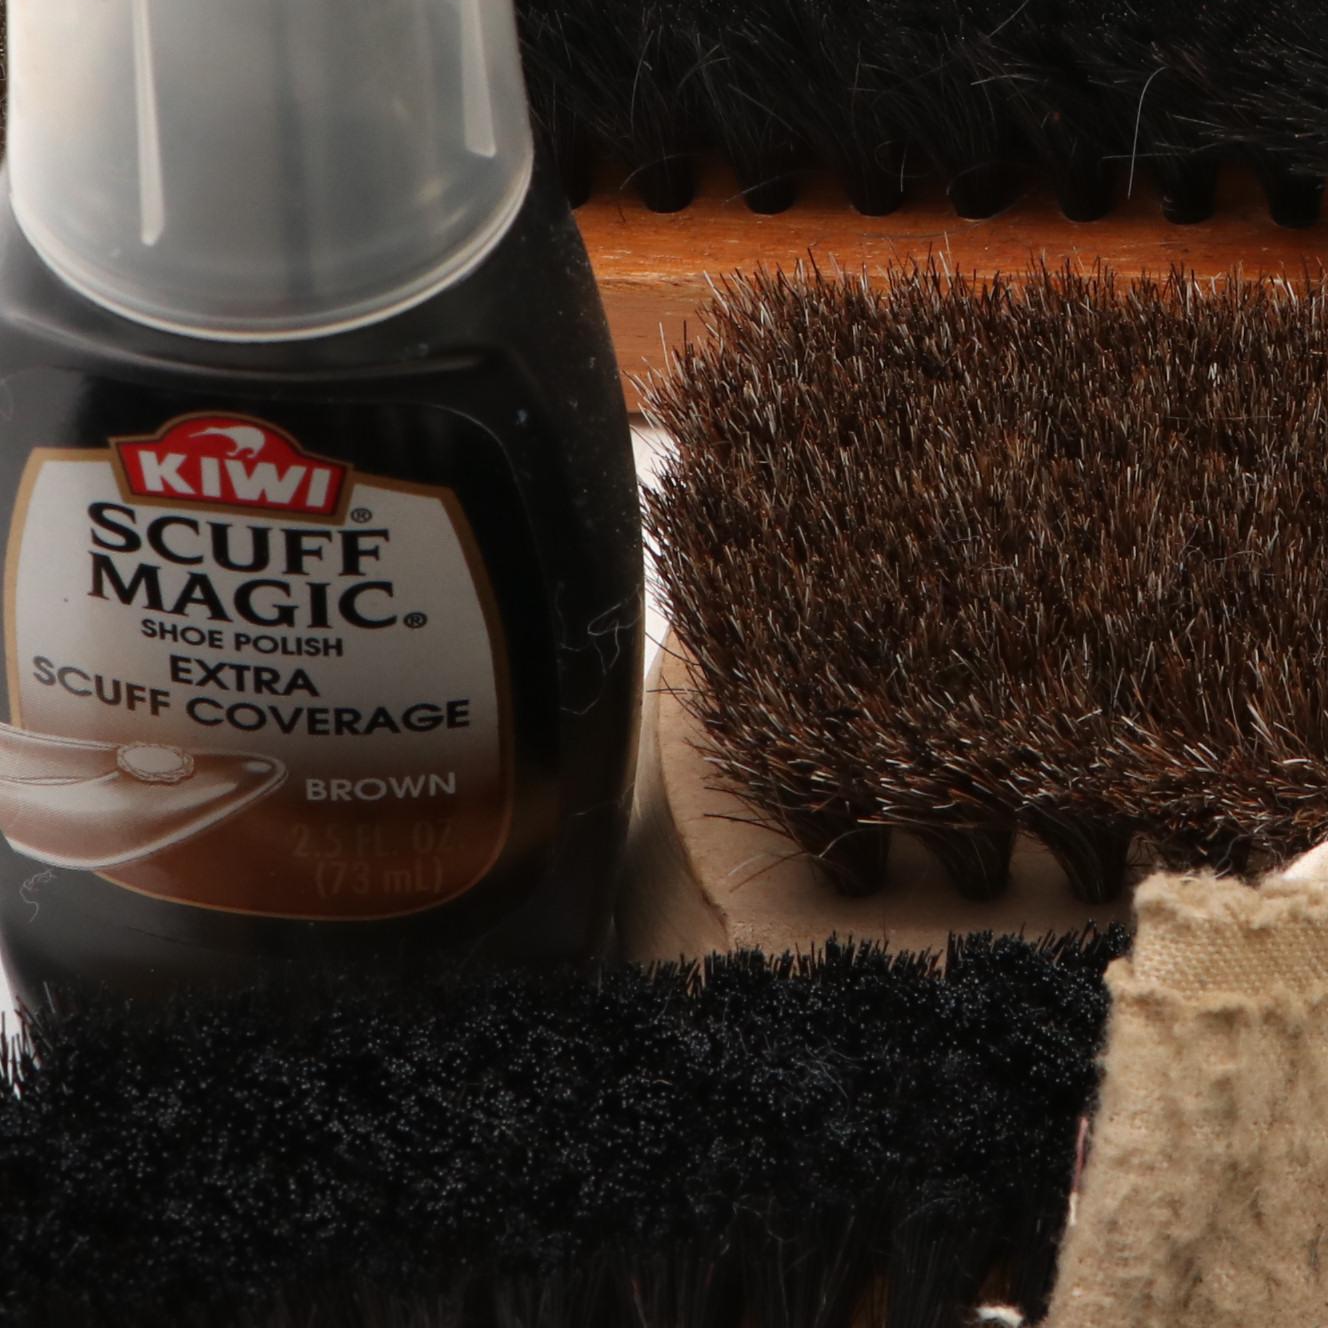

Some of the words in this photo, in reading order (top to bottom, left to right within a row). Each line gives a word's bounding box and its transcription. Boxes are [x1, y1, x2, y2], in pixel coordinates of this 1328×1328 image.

[138, 450, 333, 509] KIWI
[88, 502, 389, 577] SCUFF
[88, 551, 398, 630] MAGIC
[141, 618, 223, 651] SHOE
[235, 633, 343, 657] POLISH
[32, 655, 170, 717] SCUFF
[187, 697, 470, 735] COVERAGE
[170, 655, 318, 697] EXTRA
[306, 772, 456, 801] BROWN
